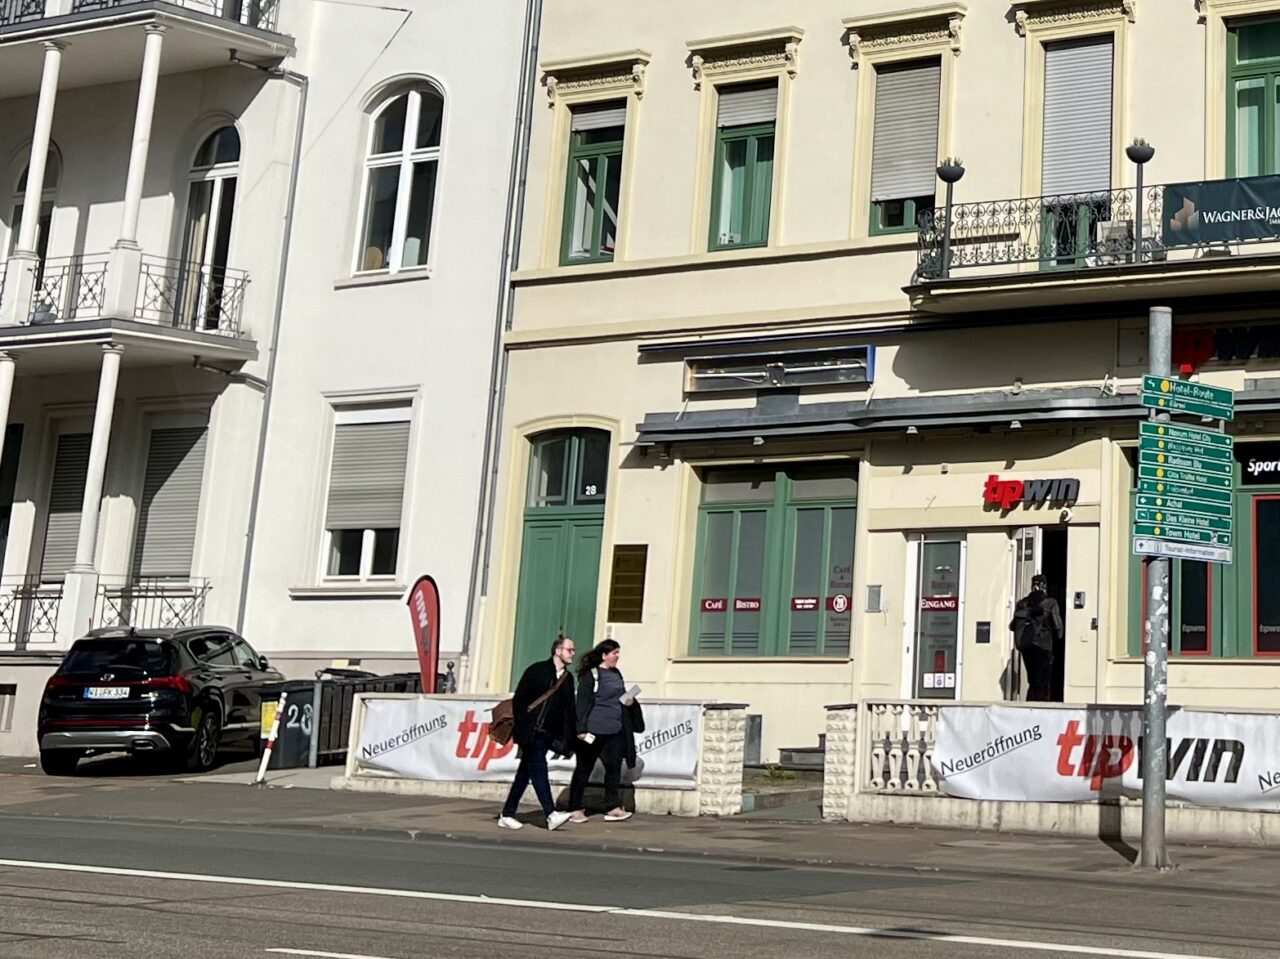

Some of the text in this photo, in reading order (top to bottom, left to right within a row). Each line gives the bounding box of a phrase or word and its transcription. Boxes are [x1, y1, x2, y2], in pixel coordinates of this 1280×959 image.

[585, 485, 597, 495] 28
[1196, 517, 1210, 526] Hotel
[1164, 527, 1200, 540] Town Hotel
[362, 713, 448, 759] Neueröffnung
[940, 723, 1043, 776] Neueröffnung
